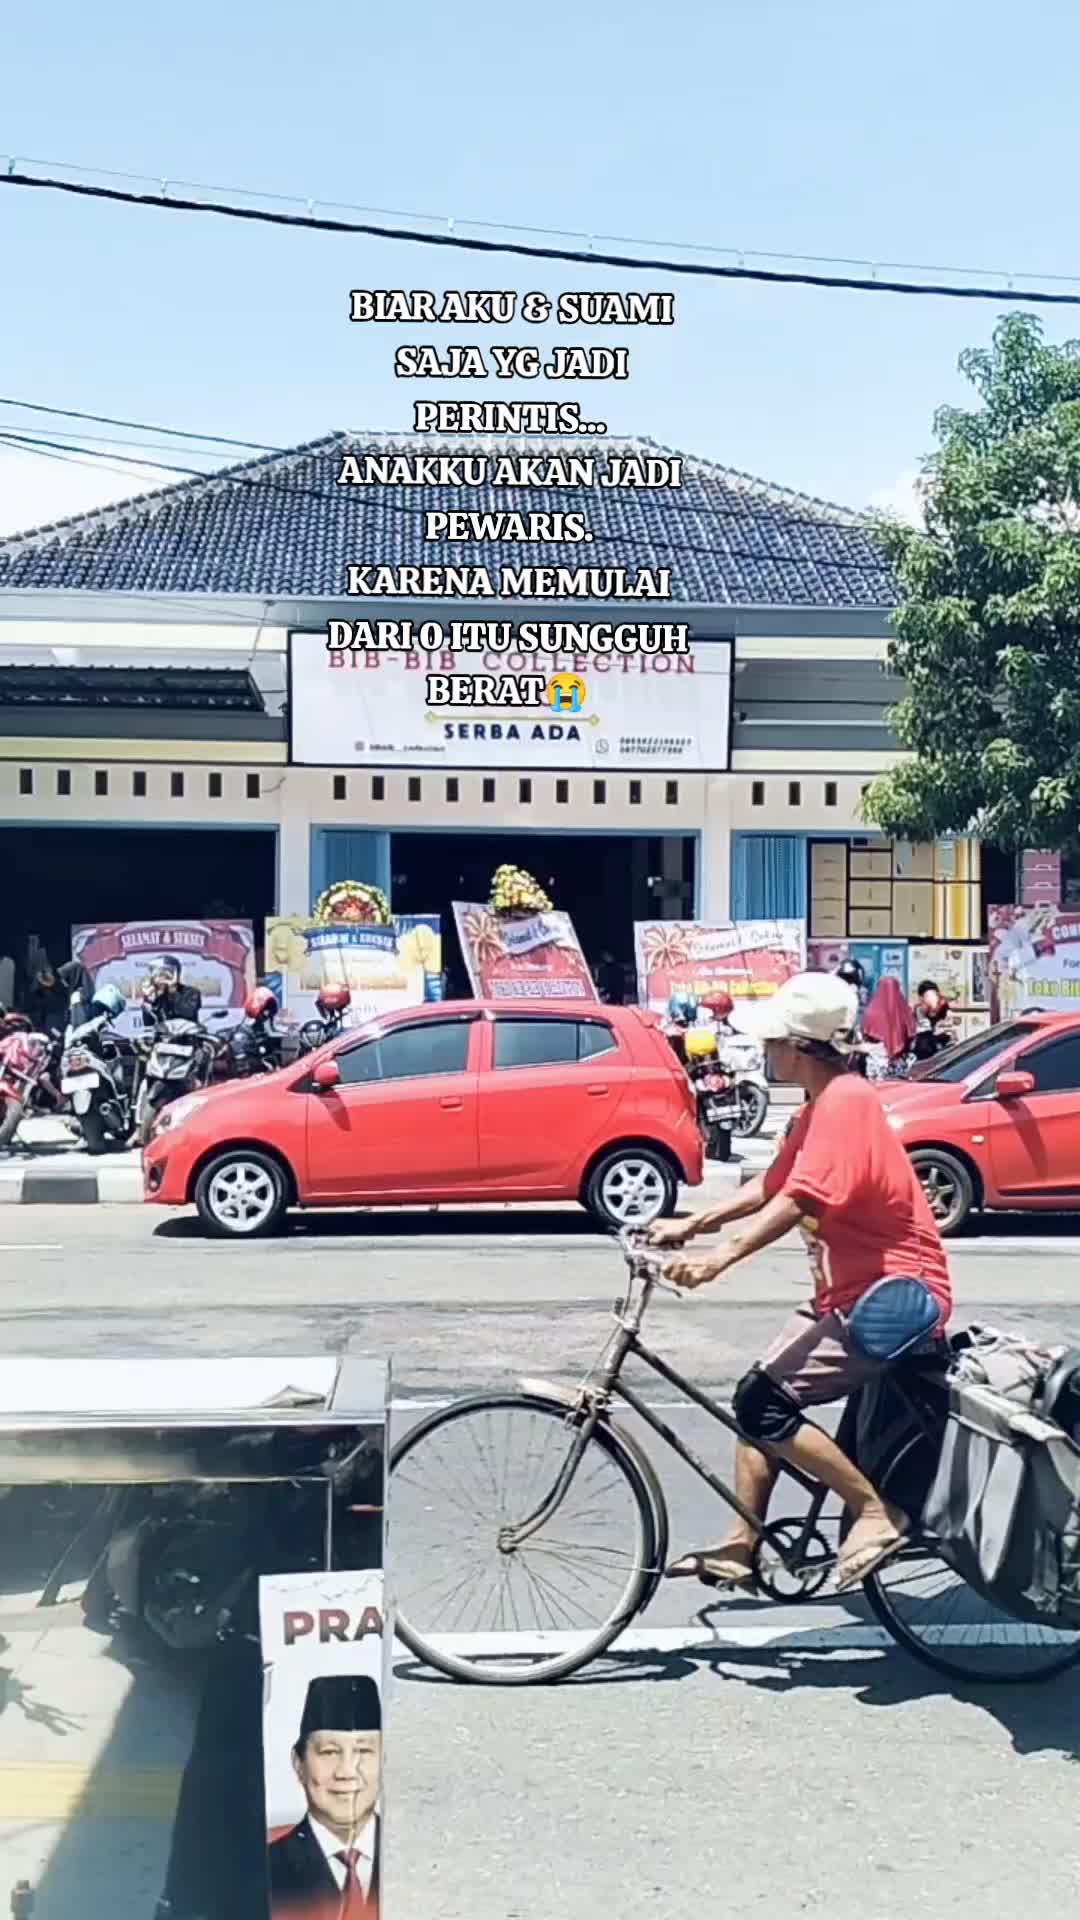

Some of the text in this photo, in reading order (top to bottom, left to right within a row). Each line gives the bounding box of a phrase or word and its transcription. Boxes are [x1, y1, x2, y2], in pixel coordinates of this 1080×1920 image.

[328, 649, 696, 673] BIB-BIB COLLECTION
[443, 723, 581, 740] SERBA ADA
[283, 1606, 383, 1645] PRA
